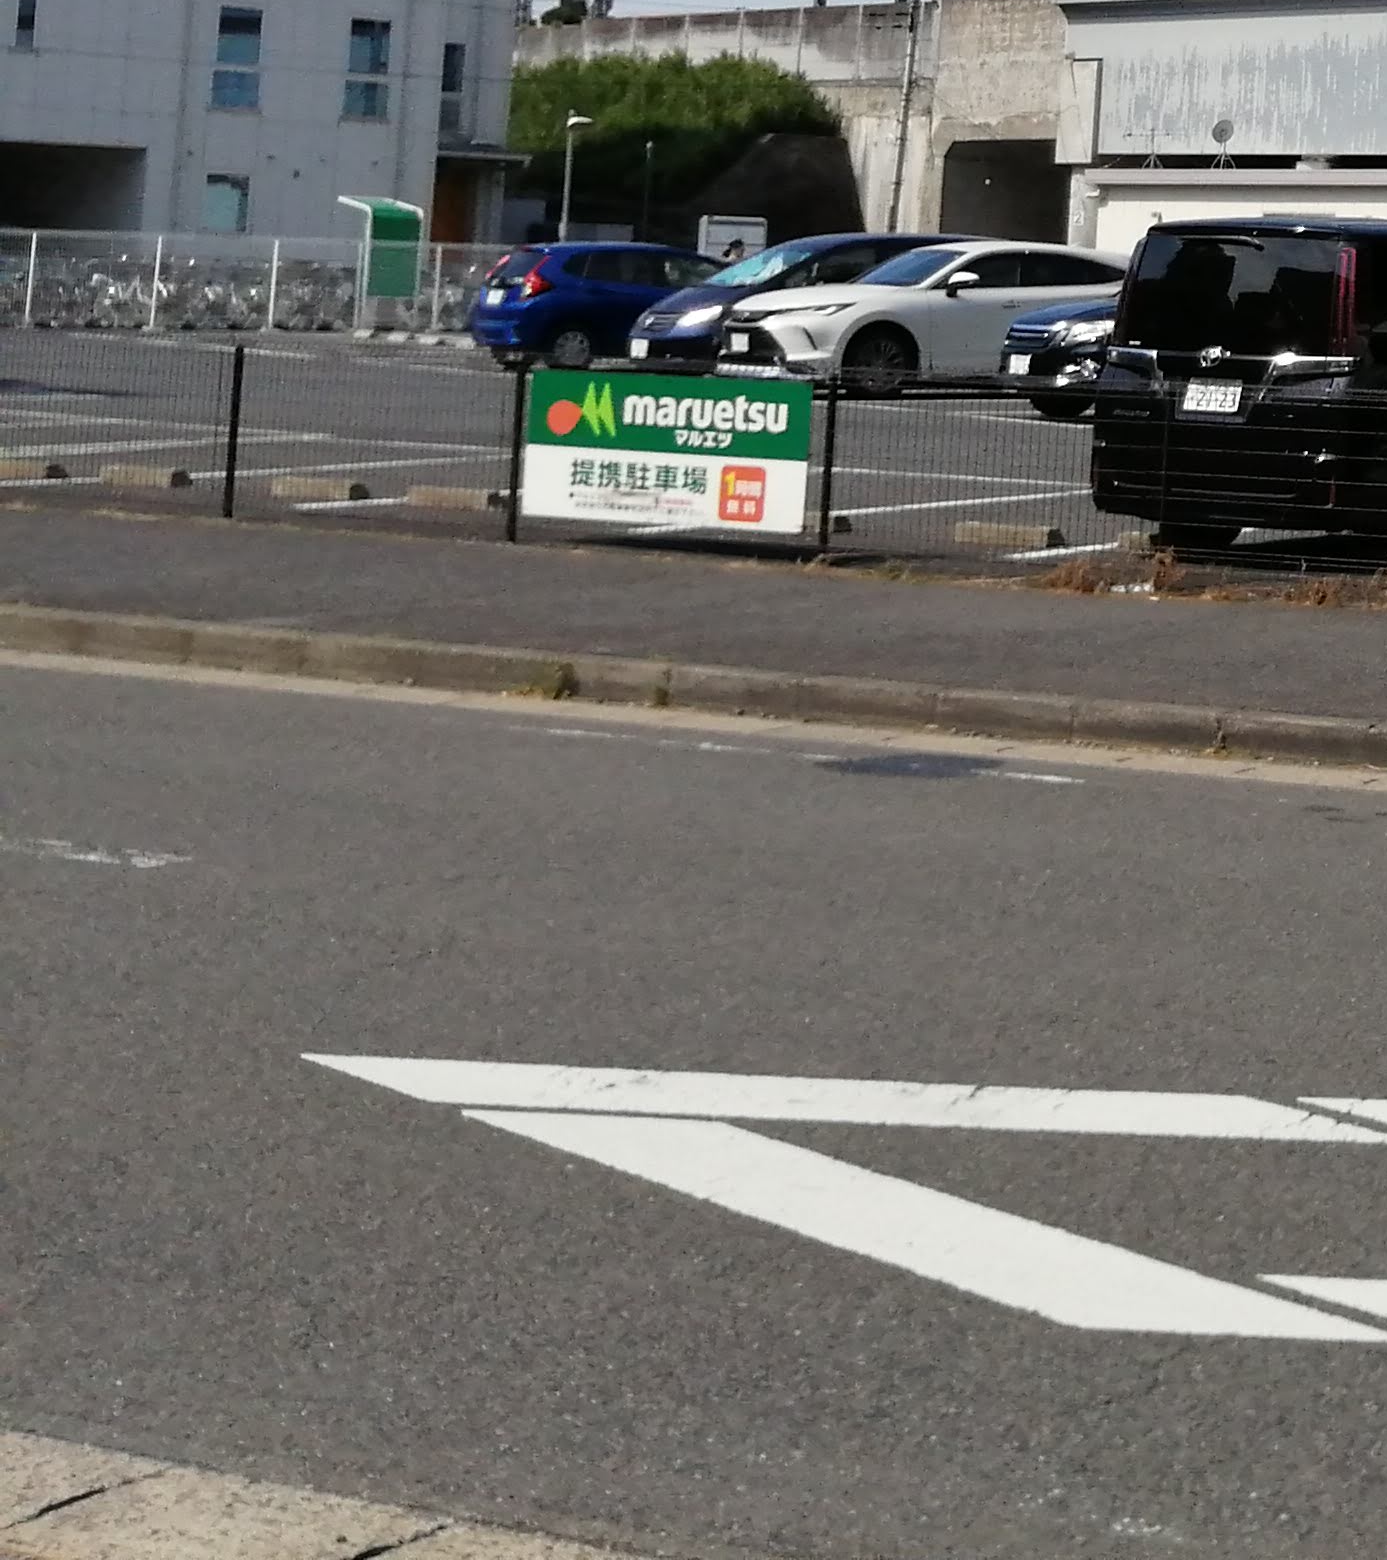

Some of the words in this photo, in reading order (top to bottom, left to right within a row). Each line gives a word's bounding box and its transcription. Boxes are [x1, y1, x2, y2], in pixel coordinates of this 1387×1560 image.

[622, 393, 789, 433] maruetsu
[674, 428, 733, 449] マルエツ
[570, 458, 709, 495] 提携駐車場
